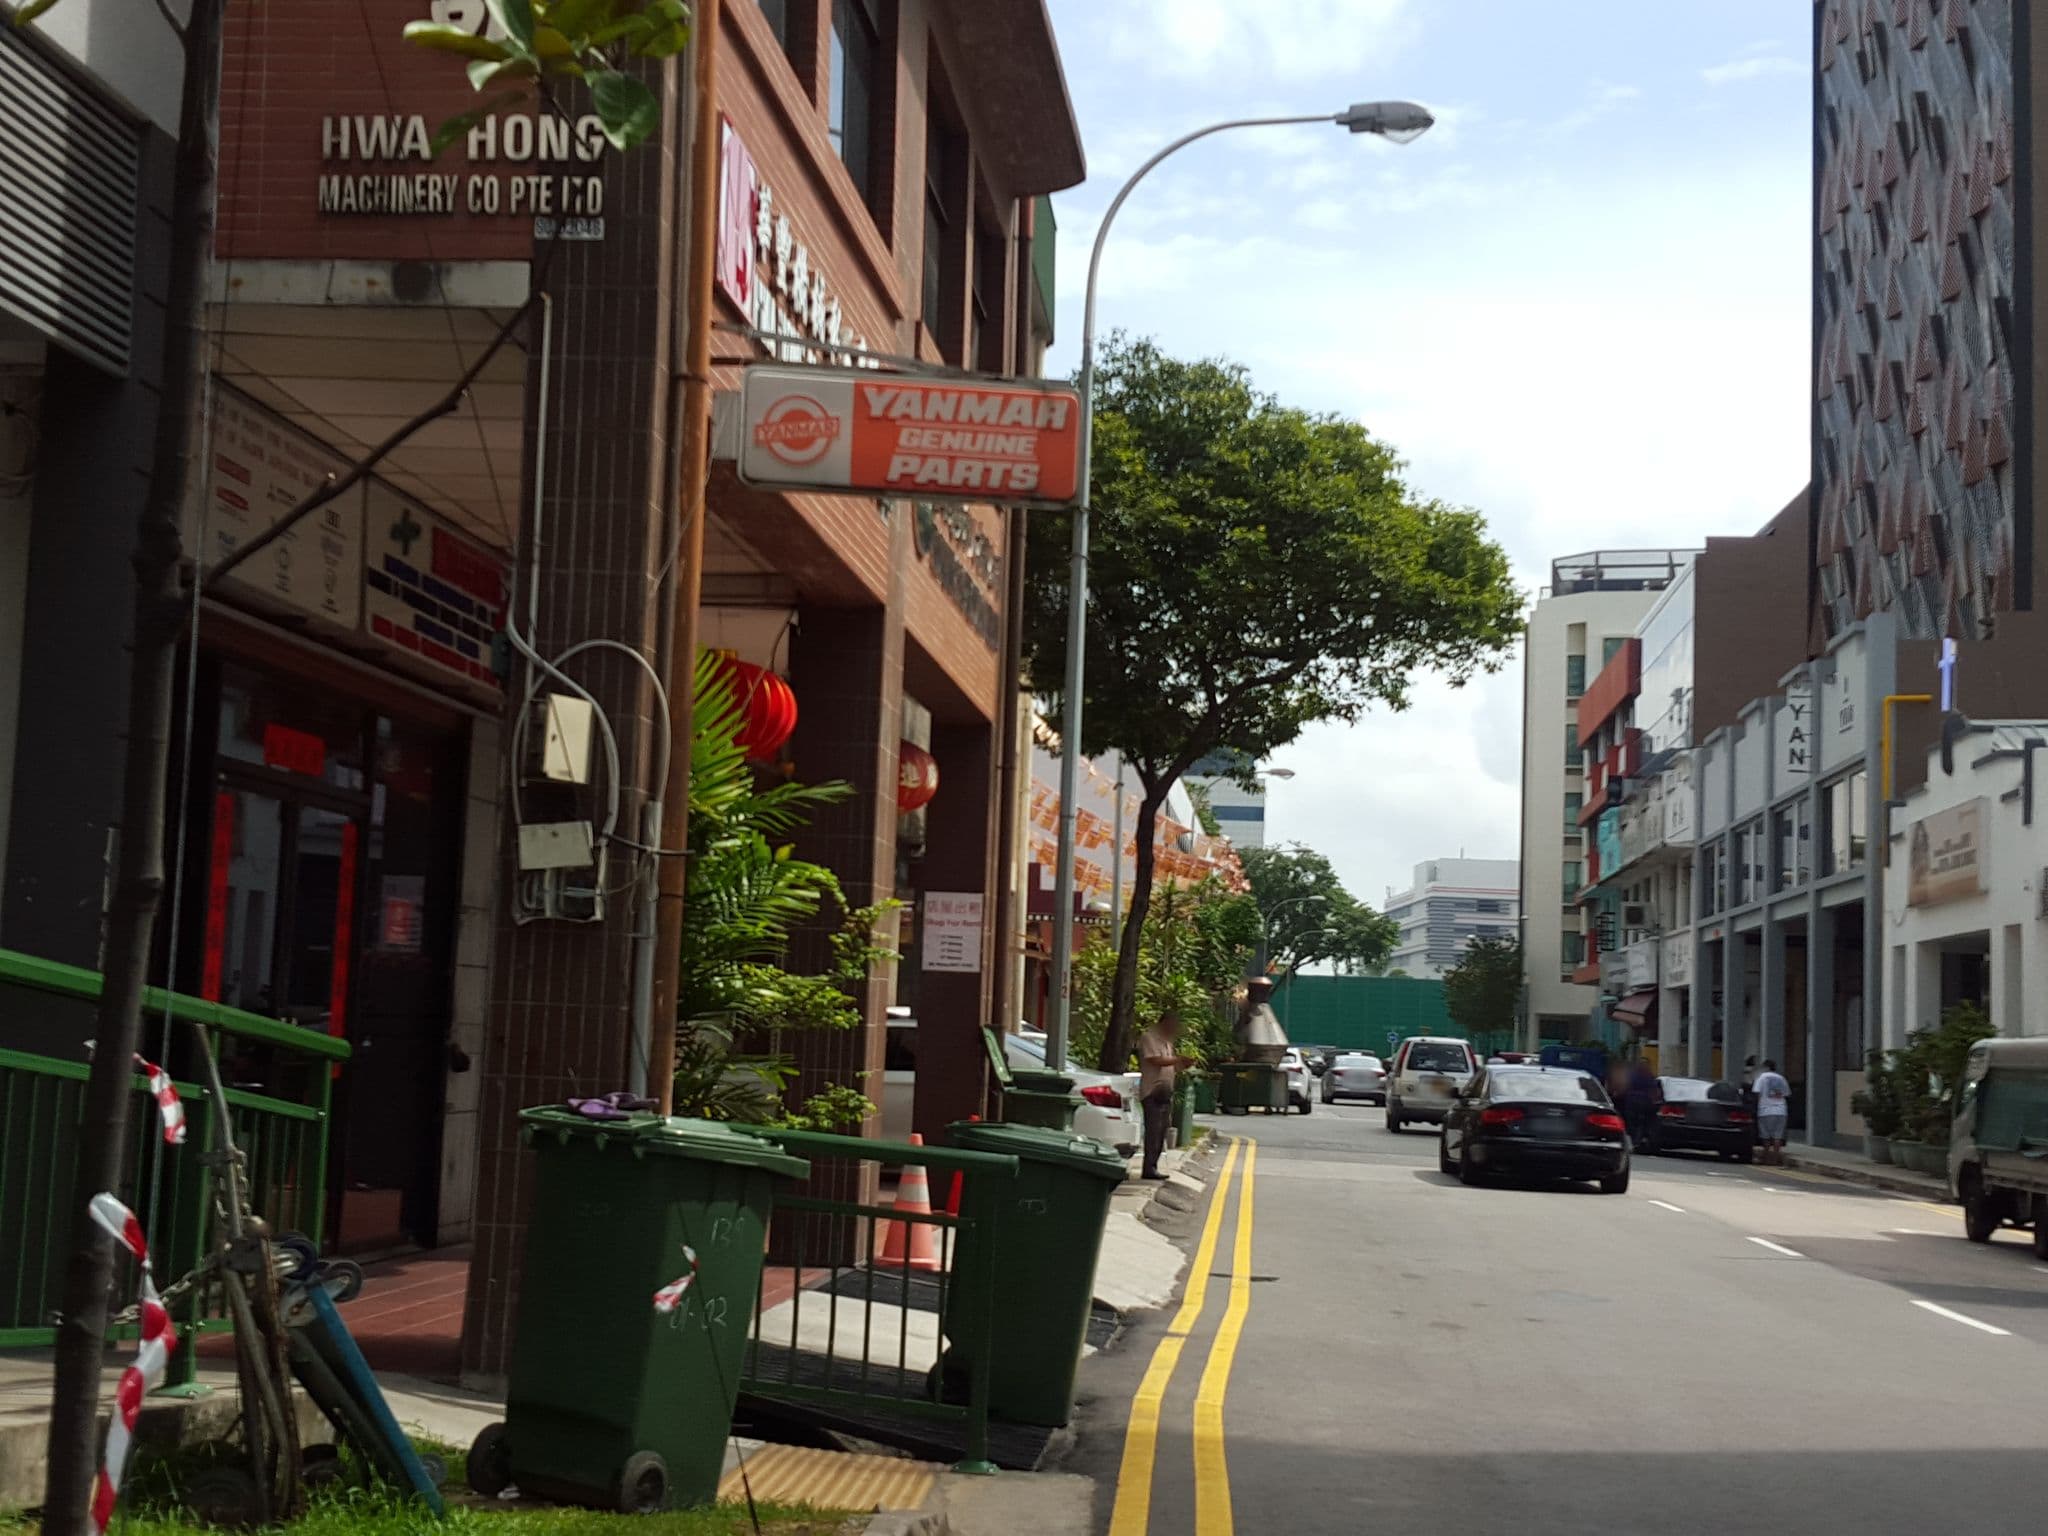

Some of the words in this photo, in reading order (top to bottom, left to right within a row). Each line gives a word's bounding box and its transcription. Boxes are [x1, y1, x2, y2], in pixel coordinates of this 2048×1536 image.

[322, 115, 432, 160] HWA
[467, 114, 605, 161] HONG
[319, 174, 459, 213] MACHINERY
[467, 175, 500, 214] CO
[510, 175, 553, 214] PTE
[863, 386, 1068, 430] YANMAR
[898, 427, 1038, 457] GENUINE
[886, 454, 1040, 490] PARTS
